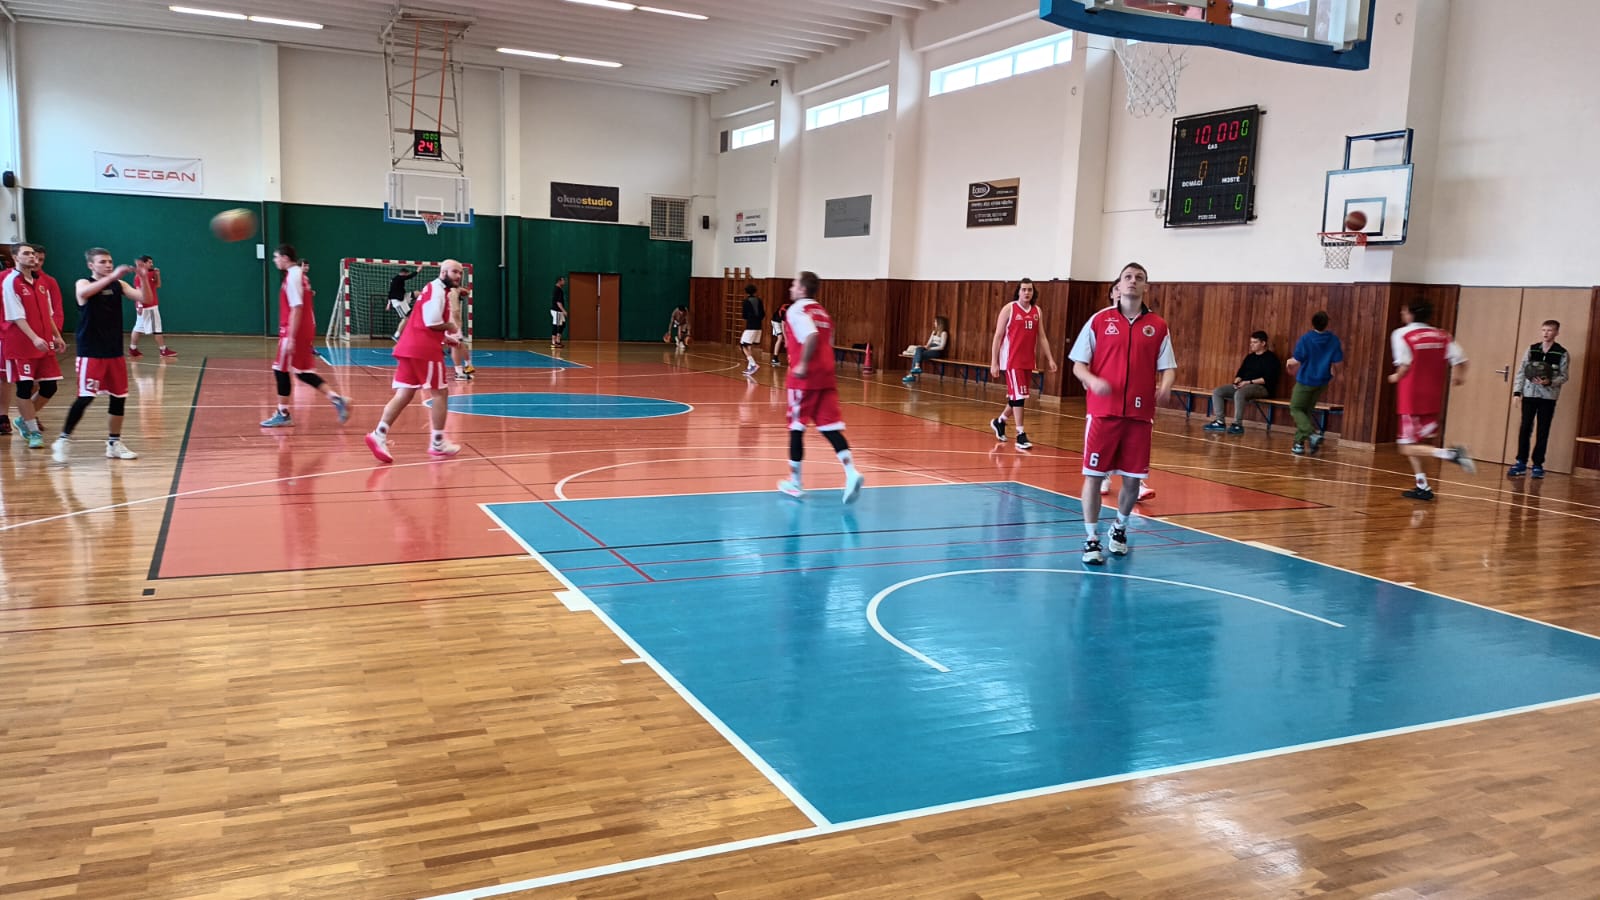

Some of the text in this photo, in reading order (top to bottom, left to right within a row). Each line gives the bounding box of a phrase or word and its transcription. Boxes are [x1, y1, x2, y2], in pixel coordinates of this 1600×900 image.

[417, 140, 433, 152] 24
[123, 168, 196, 183] CEGAN
[557, 194, 613, 207] oknostudio
[23, 363, 31, 375] 9
[1134, 396, 1142, 408] 6
[1089, 452, 1100, 467] 6
